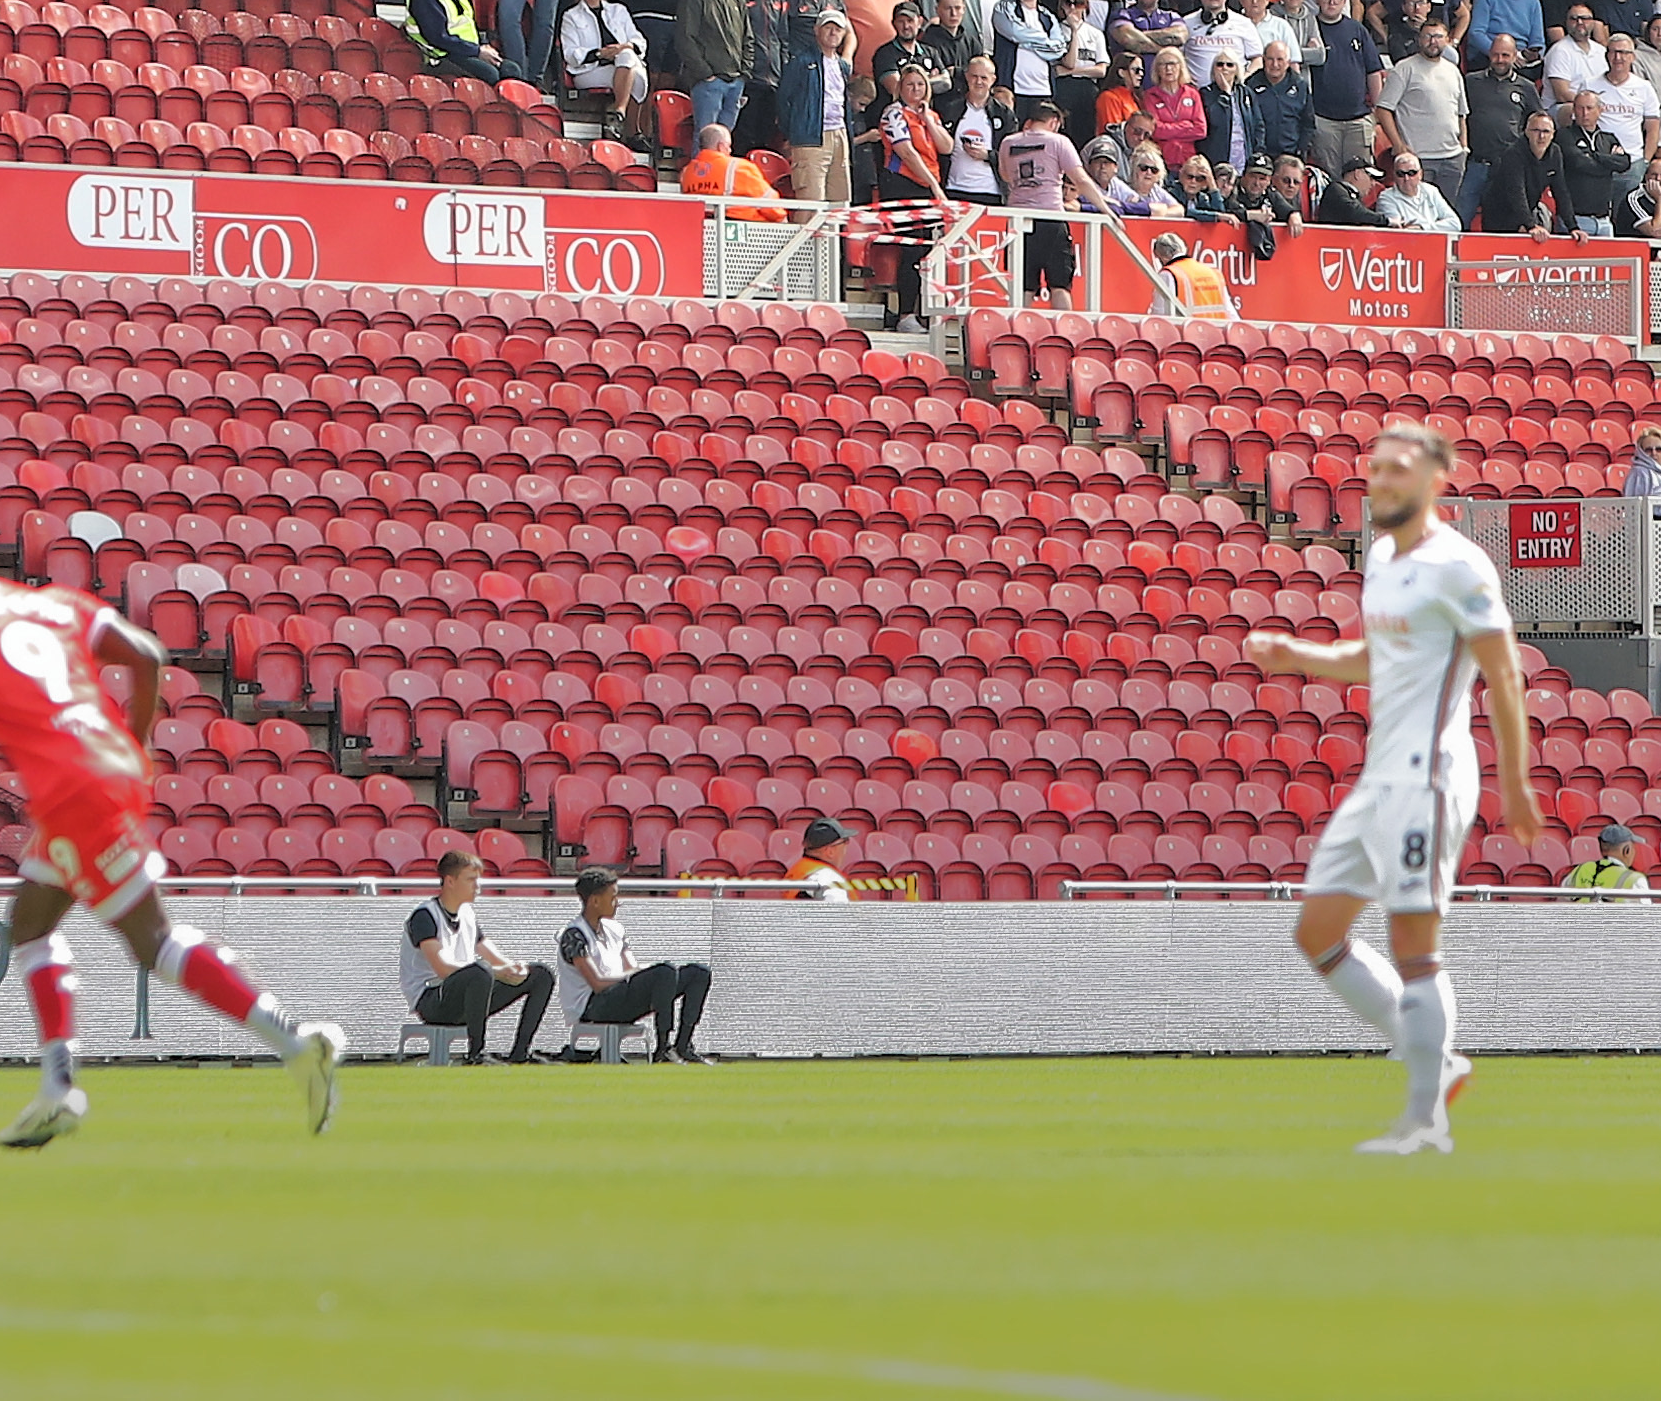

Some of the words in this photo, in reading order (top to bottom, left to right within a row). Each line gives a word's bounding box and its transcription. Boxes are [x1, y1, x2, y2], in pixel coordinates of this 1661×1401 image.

[687, 181, 719, 193] ALPHA
[89, 184, 180, 244] PER
[445, 202, 533, 259] PER
[213, 222, 293, 281] CO
[563, 237, 641, 297] CO
[1346, 247, 1425, 294] Vertu
[1349, 298, 1410, 318] Motors
[1532, 510, 1558, 533] NO
[1517, 538, 1574, 560] ENTRY
[0, 619, 74, 704] 9
[47, 834, 81, 882] 9
[1399, 828, 1428, 872] 8
